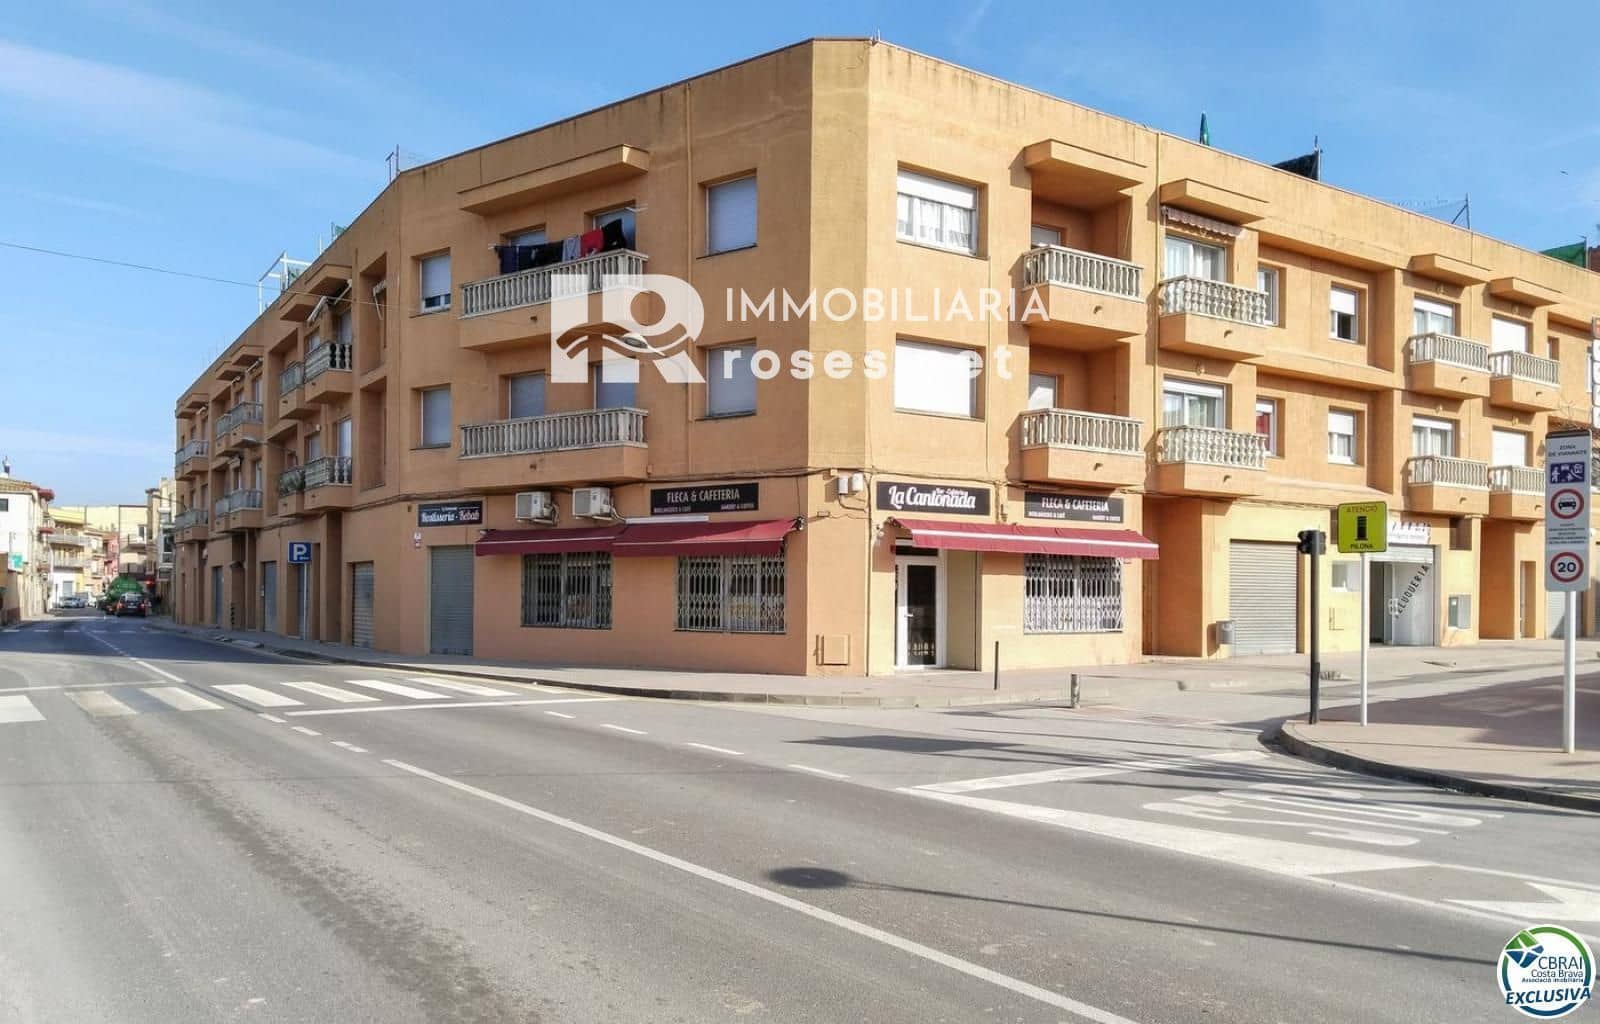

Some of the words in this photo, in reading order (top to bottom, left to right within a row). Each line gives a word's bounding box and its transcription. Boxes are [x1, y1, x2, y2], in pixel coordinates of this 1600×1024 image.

[666, 491, 689, 504] FLECA
[691, 490, 697, 502] &
[699, 487, 741, 502] CAFETERIA
[889, 483, 905, 510] La
[905, 486, 977, 509] Cantonada
[1041, 497, 1063, 510] FLECA
[1065, 499, 1071, 510] &
[1072, 499, 1110, 513] CAFETERIA
[293, 543, 307, 561] P
[1557, 561, 1577, 573] 20
